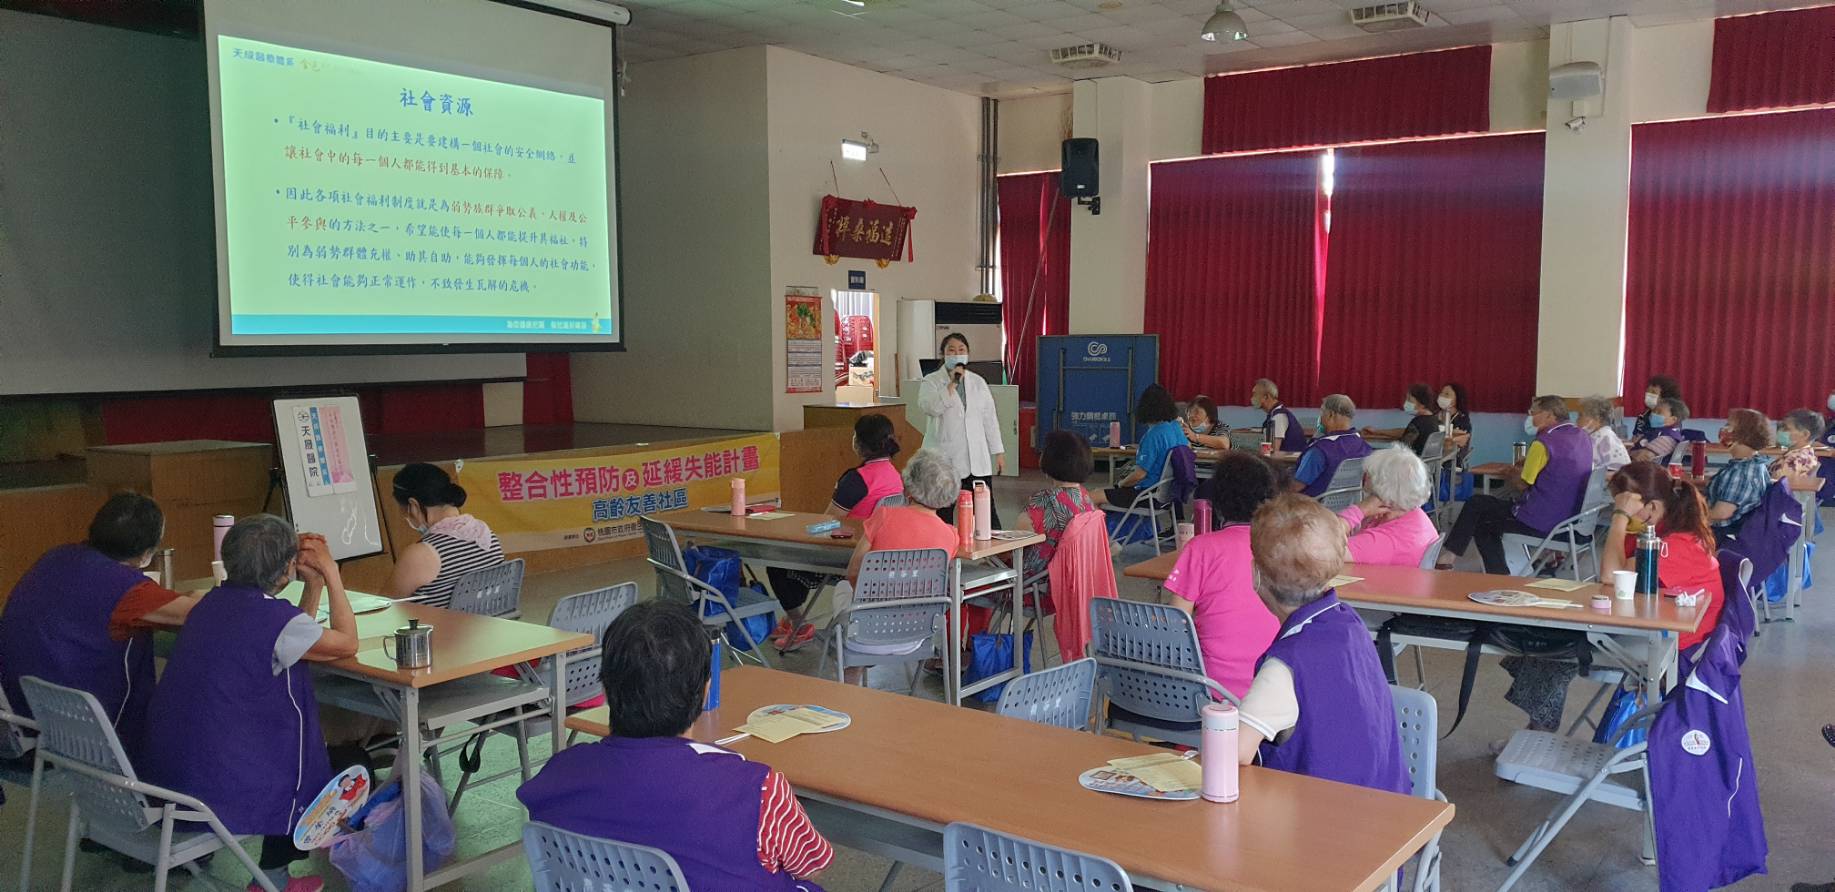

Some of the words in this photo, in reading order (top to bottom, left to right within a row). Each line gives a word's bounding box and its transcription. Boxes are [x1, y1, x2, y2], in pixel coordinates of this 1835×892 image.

[400, 88, 474, 117] 社會資源
[498, 445, 760, 502] 整合性預防及延緩失能計畫
[592, 488, 689, 521] 高齡友善社區
